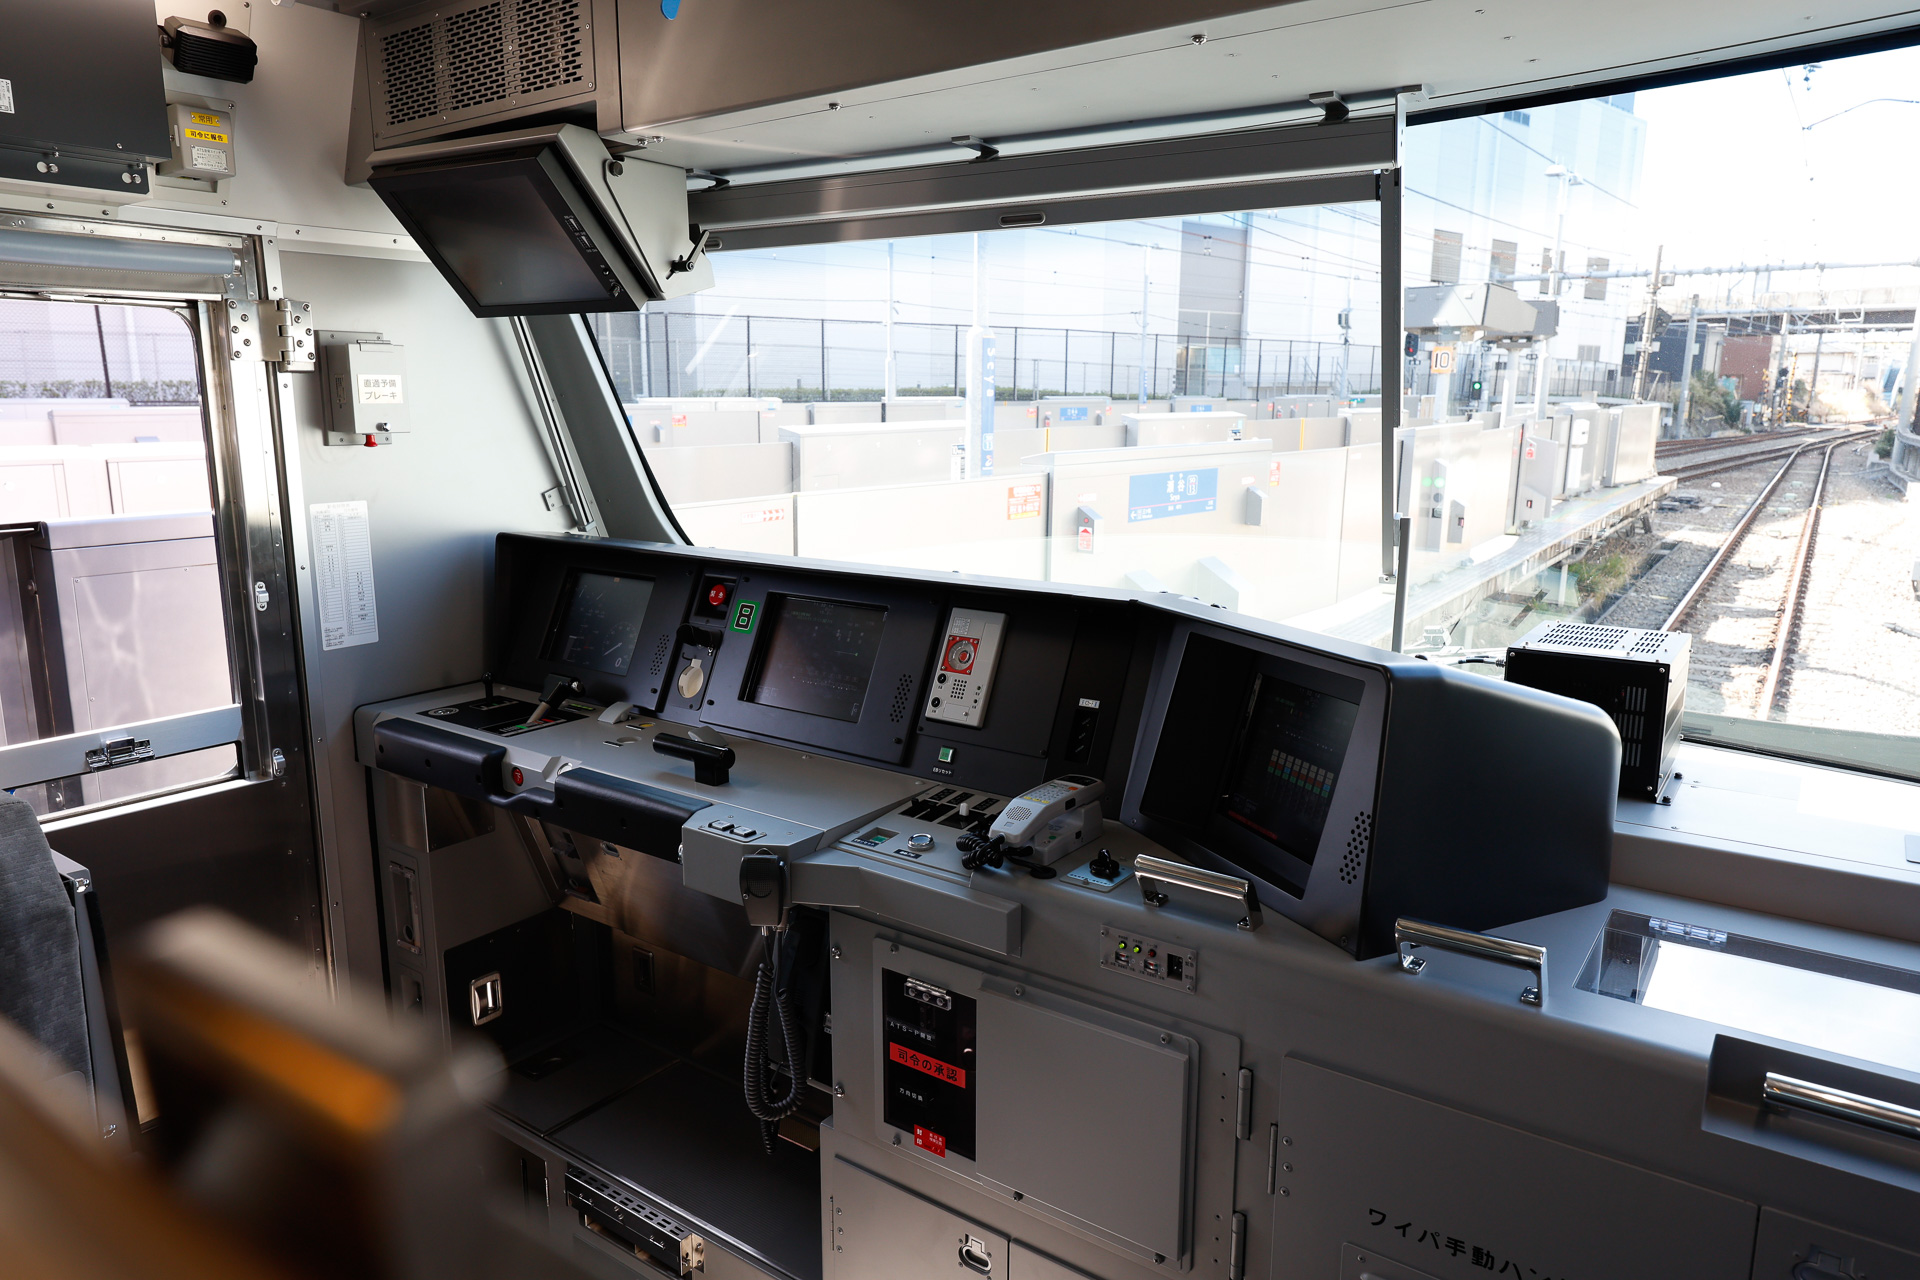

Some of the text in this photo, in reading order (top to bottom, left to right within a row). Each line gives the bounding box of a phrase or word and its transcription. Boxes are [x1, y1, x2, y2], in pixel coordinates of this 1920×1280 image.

[190, 130, 224, 142] 司令に報告
[1434, 351, 1450, 369] 10
[984, 347, 996, 397] Seya
[364, 391, 398, 401] ブレーキ
[1169, 493, 1181, 502] Seya
[710, 590, 724, 599] 緊急
[734, 602, 756, 631] 8
[897, 1047, 958, 1082] 司令の承認
[899, 1087, 923, 1101] 方向切換
